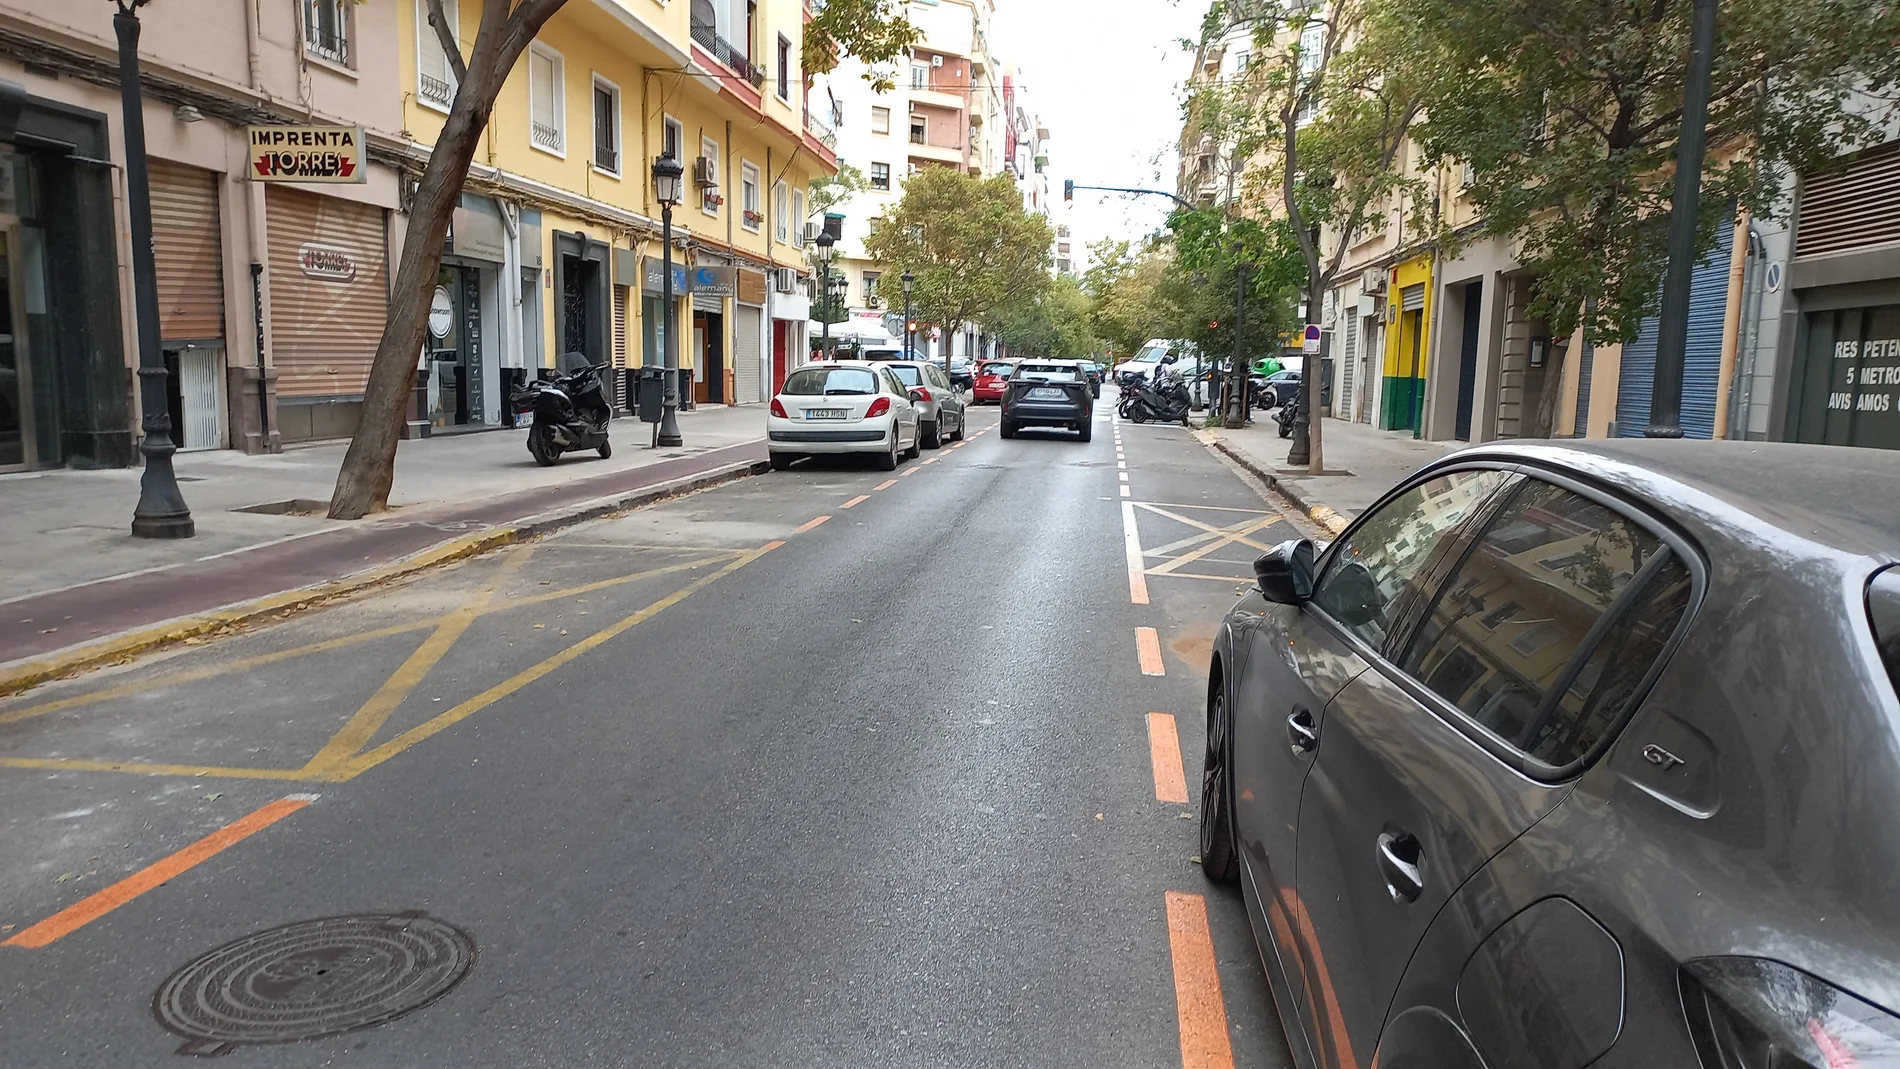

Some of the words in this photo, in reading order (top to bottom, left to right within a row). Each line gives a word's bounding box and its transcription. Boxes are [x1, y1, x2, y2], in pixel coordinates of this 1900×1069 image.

[252, 131, 354, 146] IMPRENTA
[265, 151, 343, 174] TORRES
[1834, 341, 1858, 358] RES
[1846, 367, 1855, 384] 5
[1860, 367, 1900, 385] METRO
[1643, 743, 1684, 771] GT
